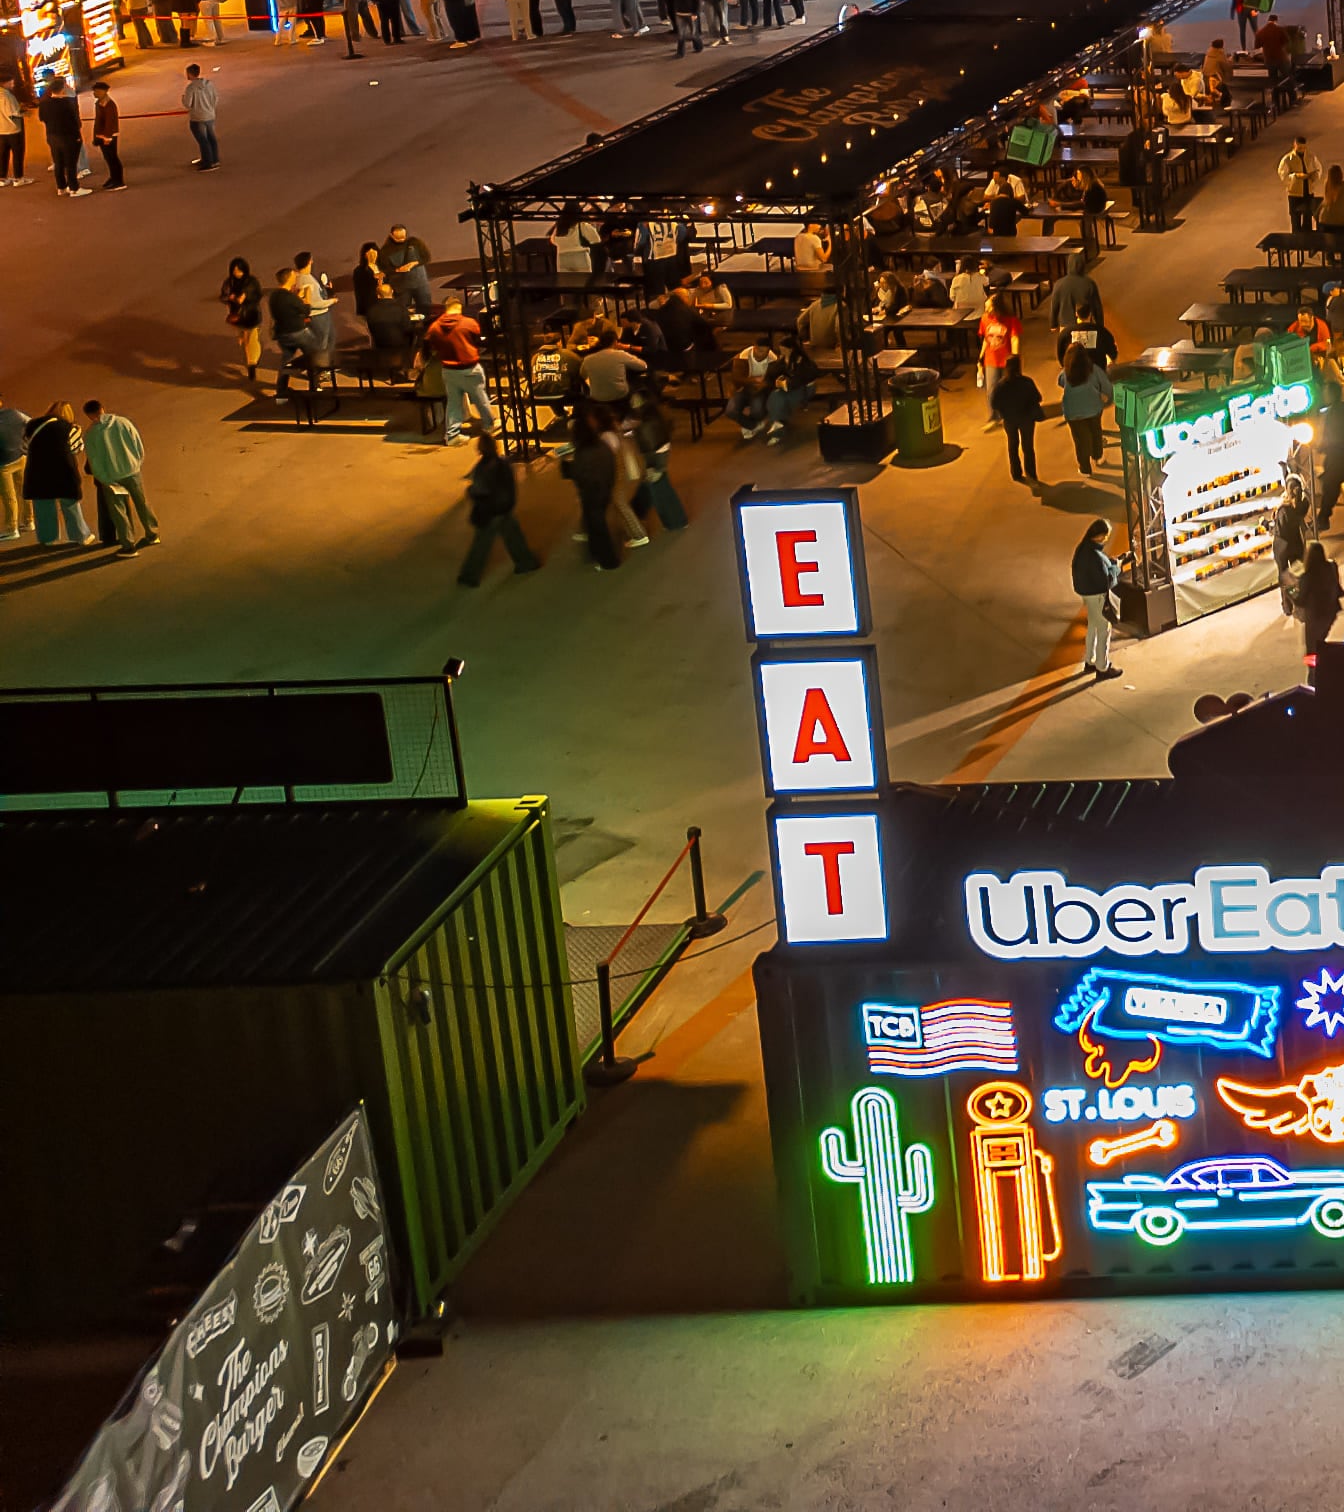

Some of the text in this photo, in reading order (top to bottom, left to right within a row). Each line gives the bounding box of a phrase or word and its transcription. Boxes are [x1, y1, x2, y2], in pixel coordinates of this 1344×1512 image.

[1145, 383, 1312, 459] Uber Eats
[775, 530, 855, 915] EAT
[979, 883, 1187, 946] Uber
[868, 1014, 915, 1039] TCB
[201, 1338, 289, 1481] Champions
[217, 1336, 253, 1413] The
[224, 1384, 286, 1493] Burger
